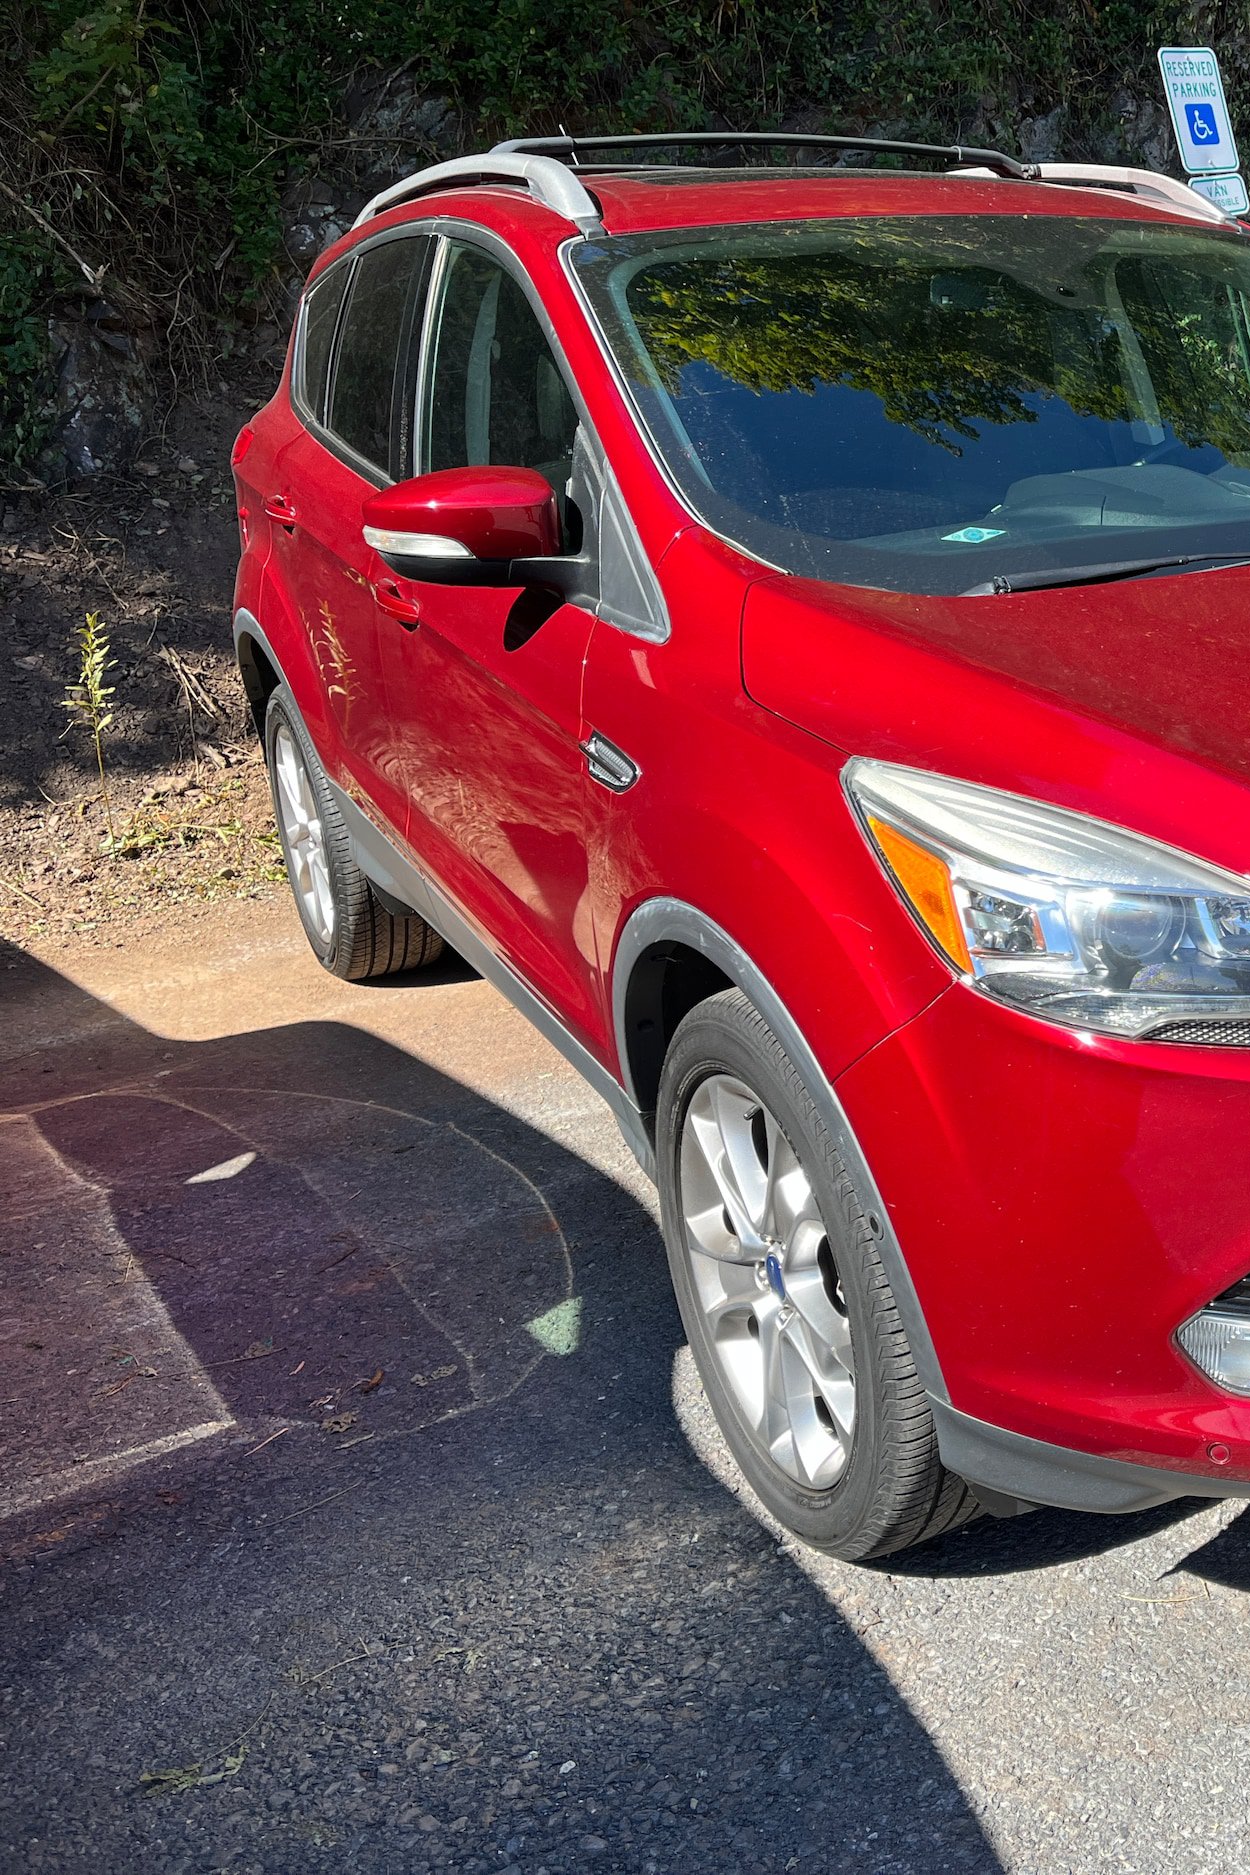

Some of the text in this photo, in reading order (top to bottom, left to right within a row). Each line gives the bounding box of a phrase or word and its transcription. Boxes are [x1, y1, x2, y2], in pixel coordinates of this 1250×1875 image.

[1165, 61, 1214, 77] RESERVED
[1172, 82, 1217, 98] PARKING
[1206, 184, 1228, 197] VAN
